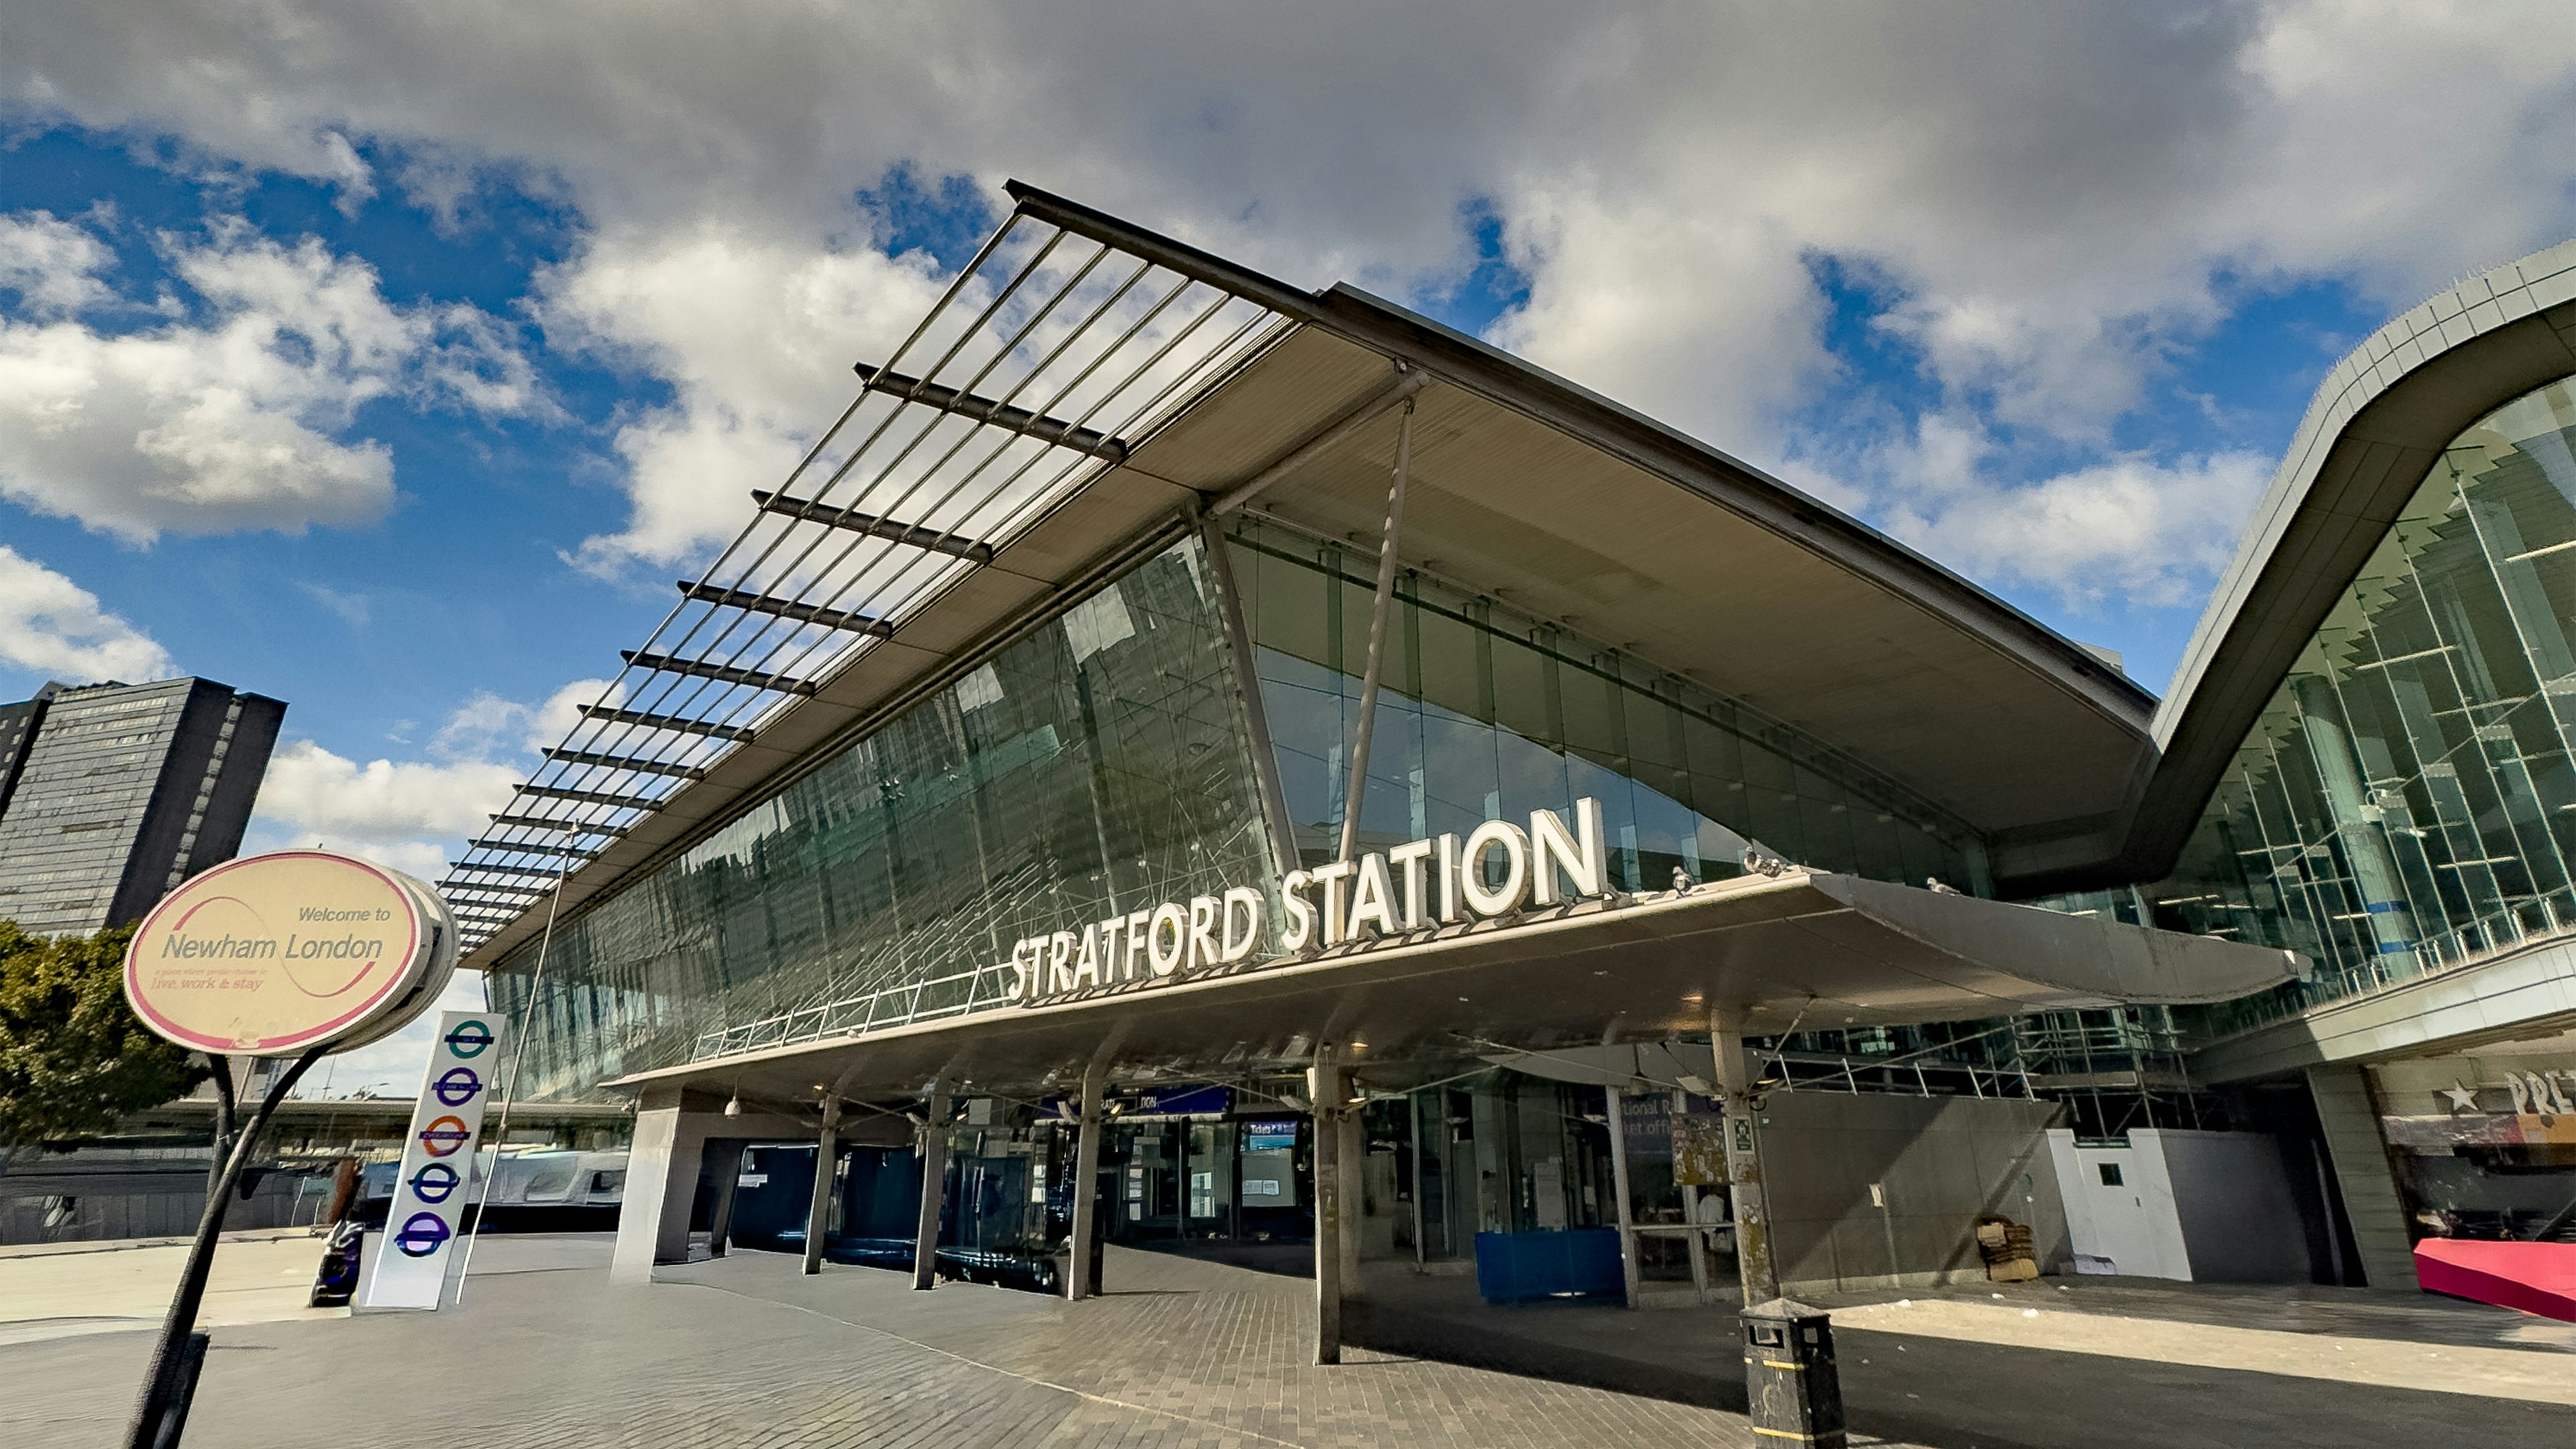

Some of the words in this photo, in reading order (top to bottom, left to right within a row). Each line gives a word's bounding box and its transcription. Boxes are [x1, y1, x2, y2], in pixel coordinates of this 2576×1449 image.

[1008, 885, 1265, 1002] STRATFORD
[1281, 796, 1607, 951] STATION
[299, 907, 370, 922] Welcome
[376, 908, 391, 922] to
[161, 933, 277, 959] Newham
[284, 933, 383, 959] London
[181, 977, 216, 989] work
[219, 978, 230, 989] &
[233, 978, 264, 992] stay
[1621, 1099, 1658, 1116] tional
[1647, 1119, 1671, 1135] offi
